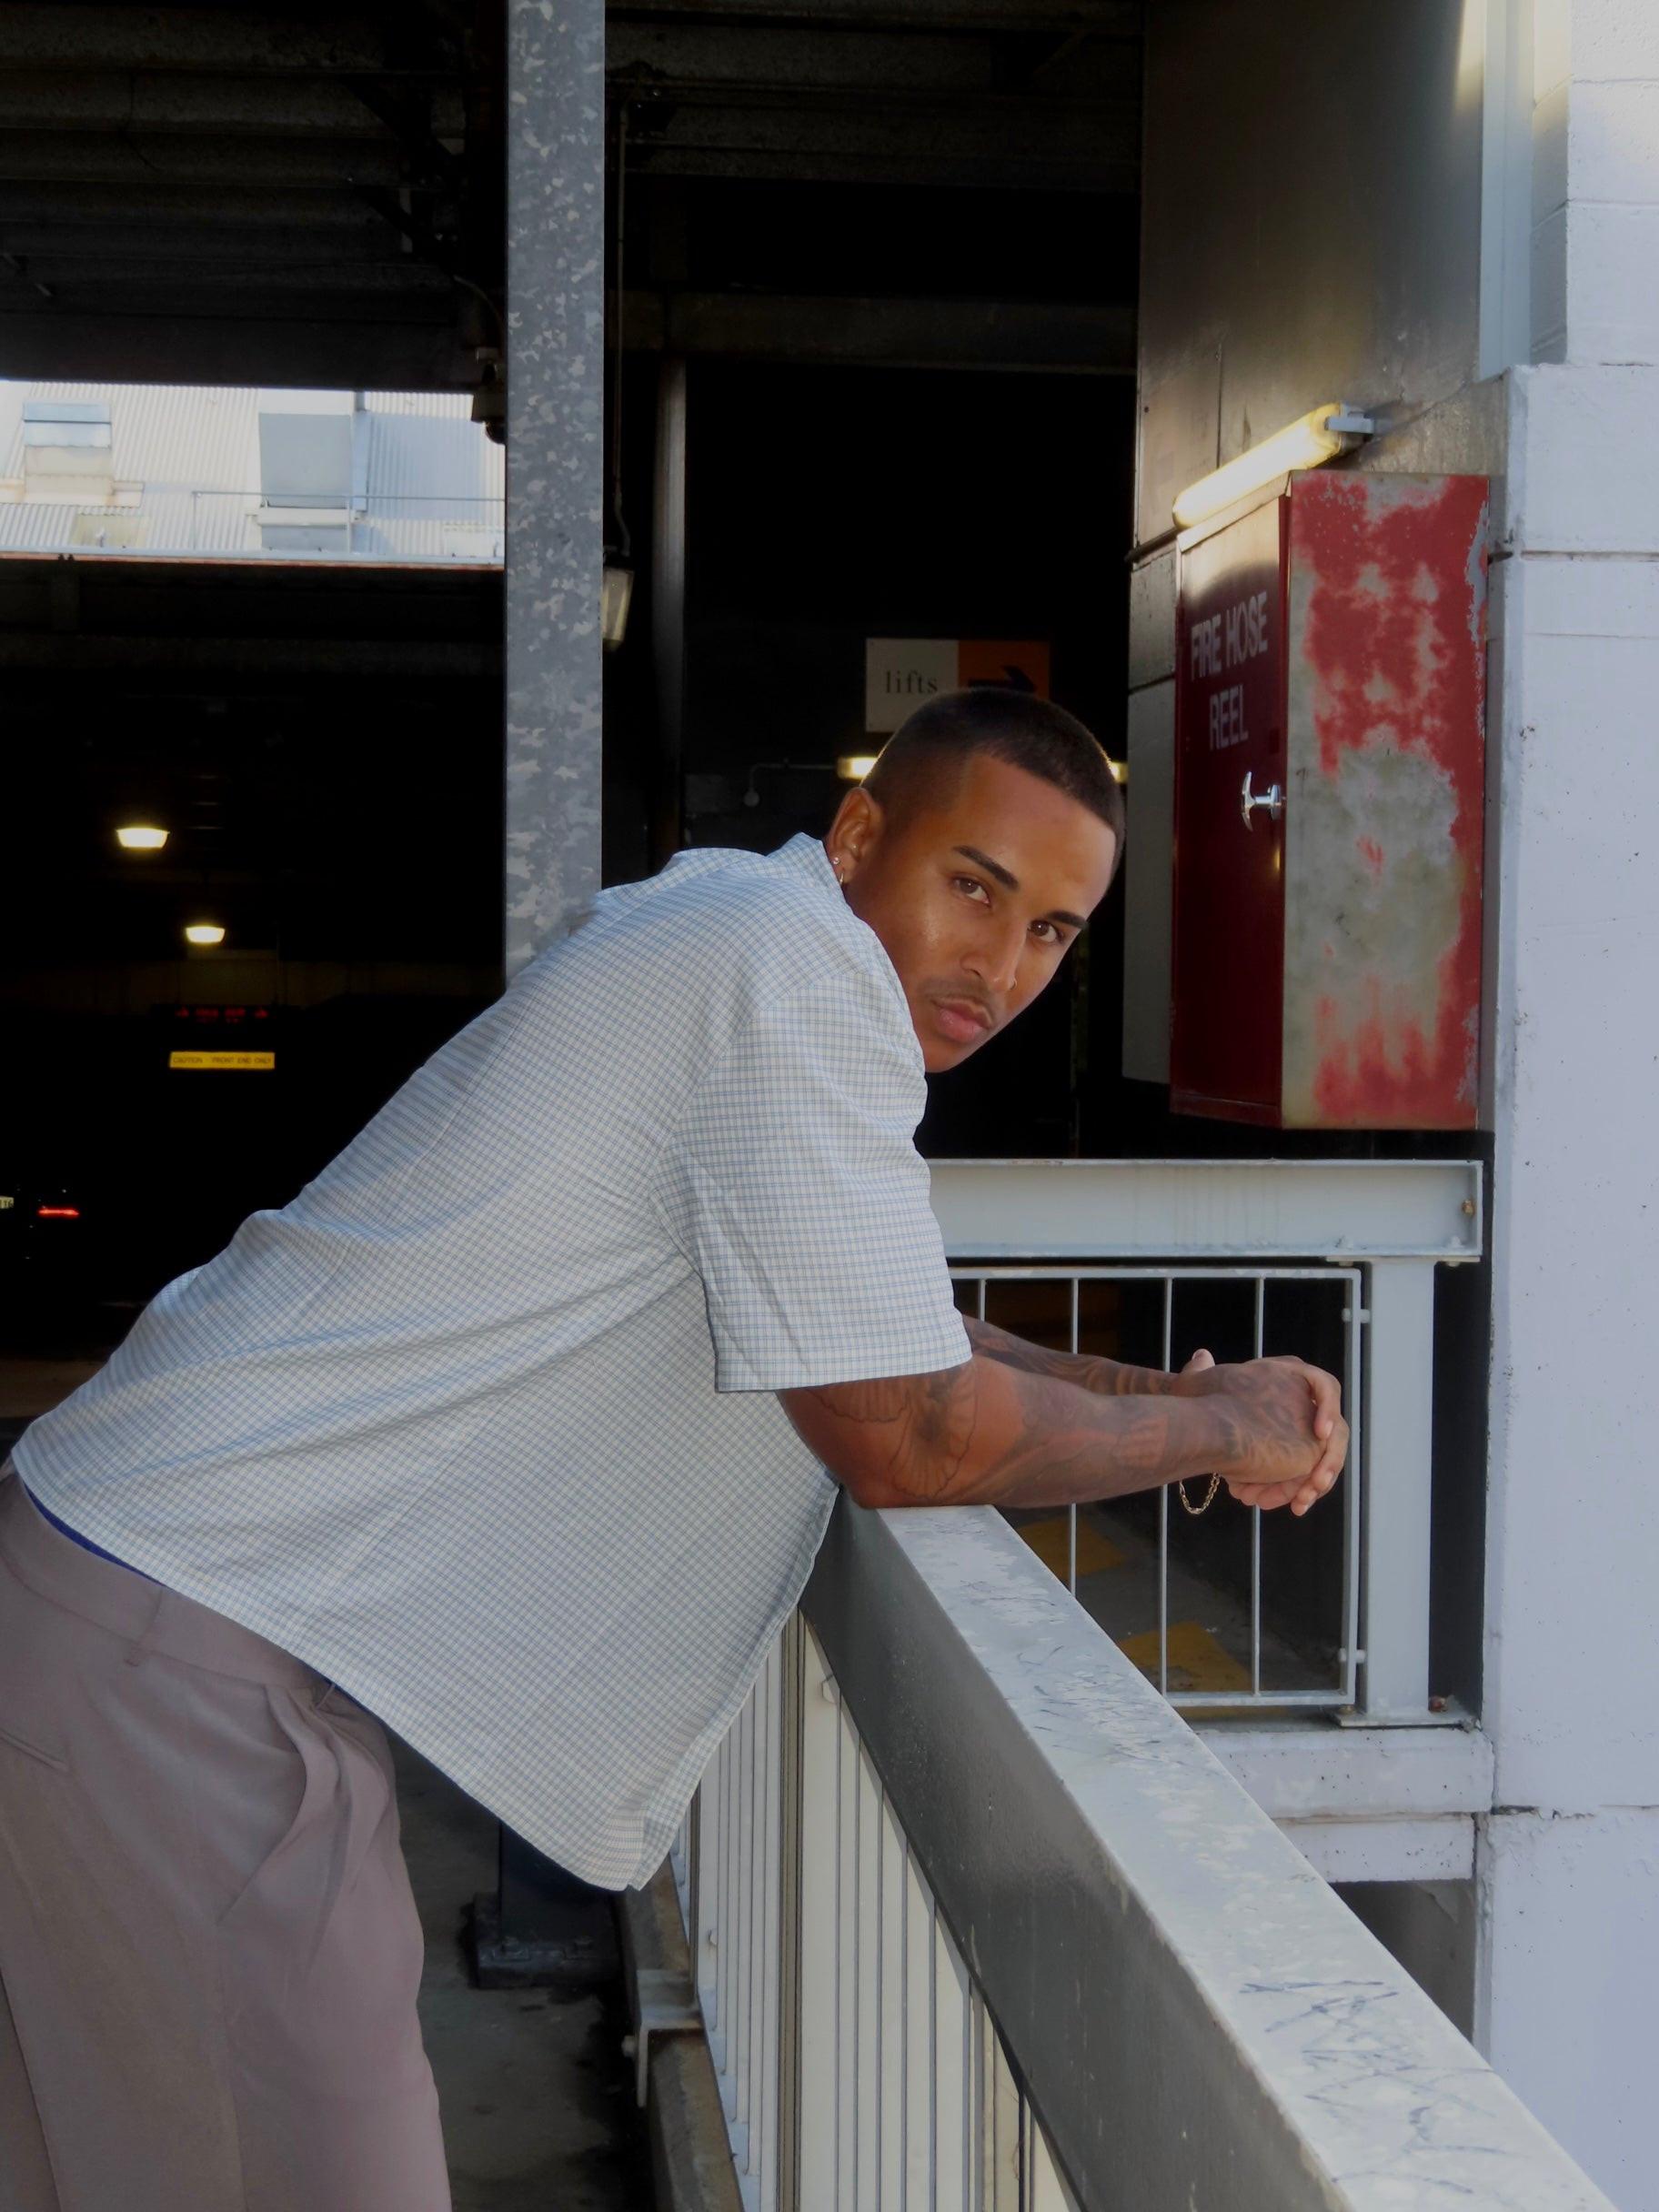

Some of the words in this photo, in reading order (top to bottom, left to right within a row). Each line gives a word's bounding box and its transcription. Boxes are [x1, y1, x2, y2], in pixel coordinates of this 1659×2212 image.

[1191, 613, 1222, 682] FIRE
[1226, 591, 1269, 669] HOSE
[885, 669, 938, 694] lifts
[1209, 684, 1249, 751] REEL
